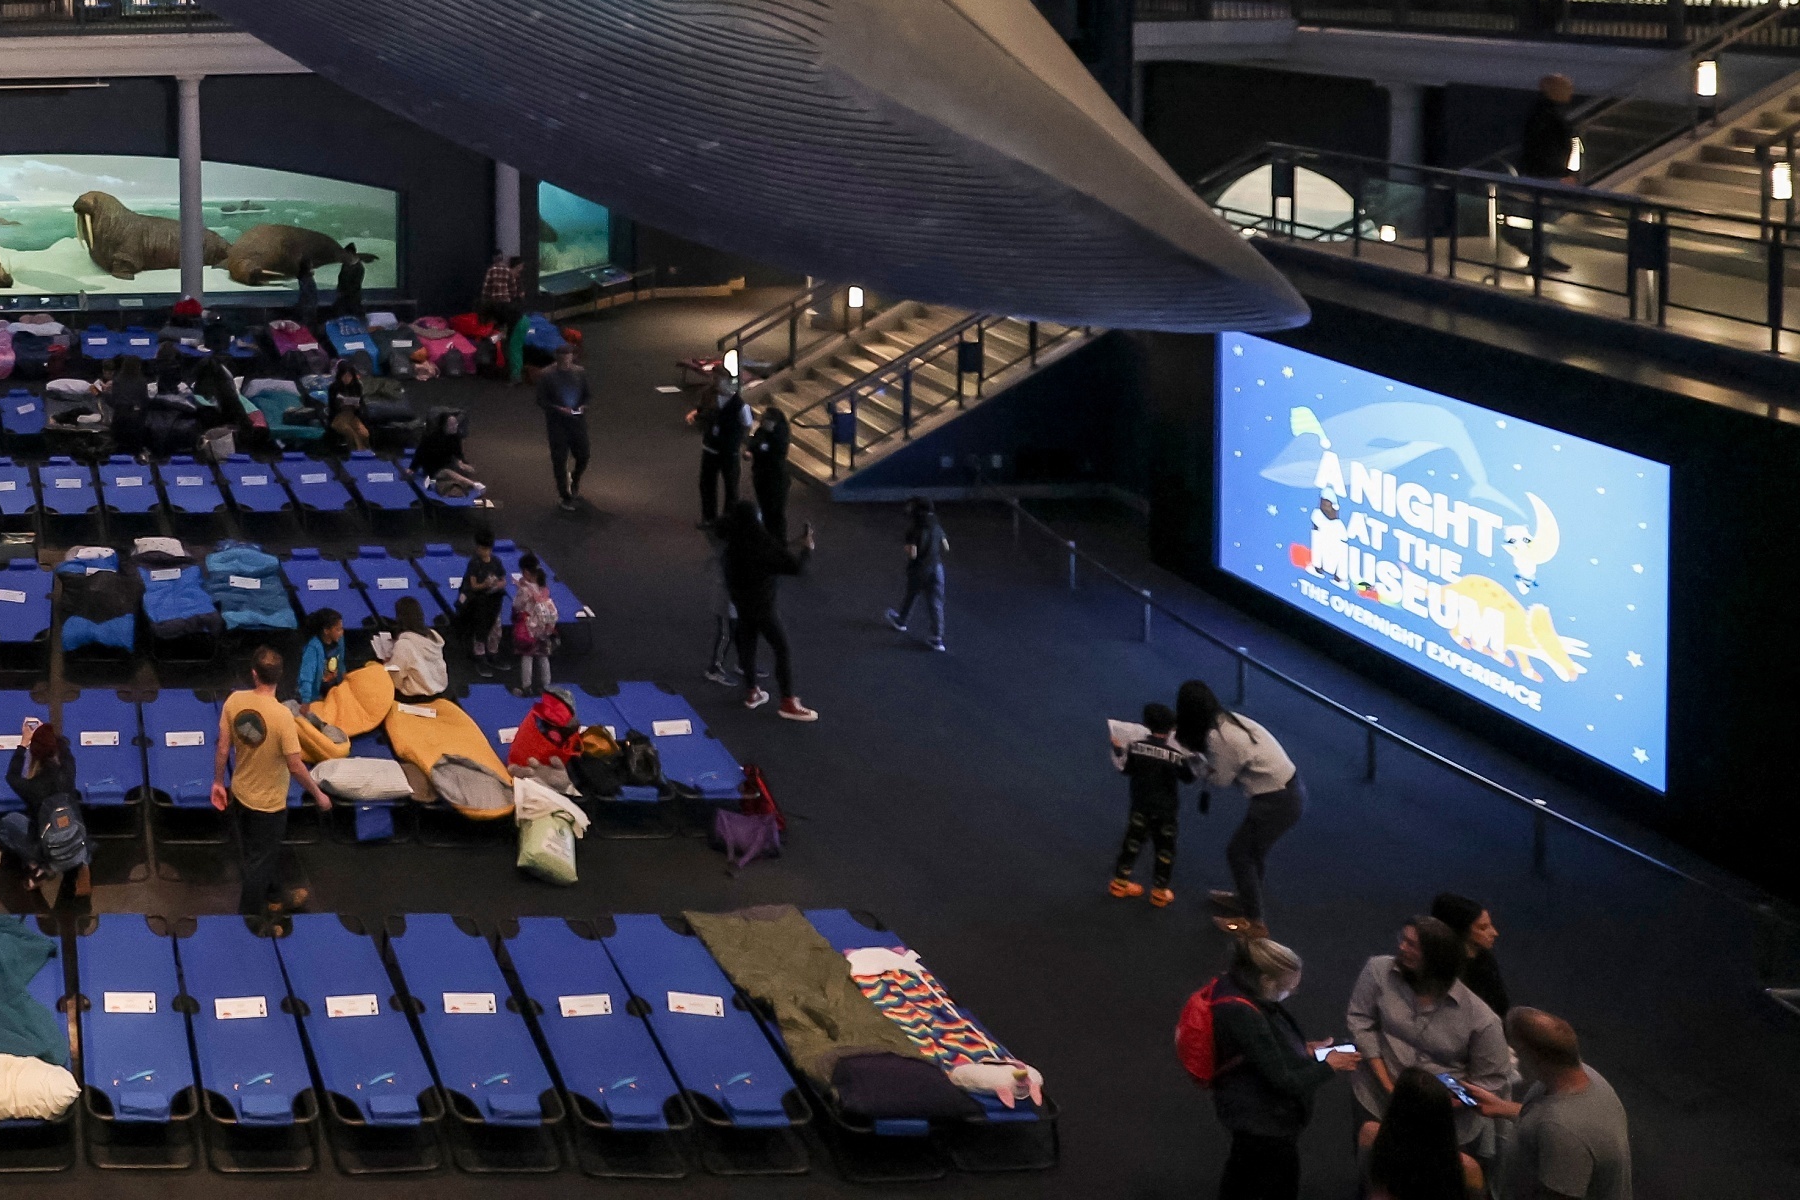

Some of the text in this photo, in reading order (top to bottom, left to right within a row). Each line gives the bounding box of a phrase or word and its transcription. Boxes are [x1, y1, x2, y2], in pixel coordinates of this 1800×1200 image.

[1314, 451, 1503, 557] A NIGHT
[1347, 512, 1463, 584] AT THE
[1298, 579, 1542, 711] THE OVERNIGHT EXPERIENCE
[1311, 529, 1505, 656] MUSEUM
